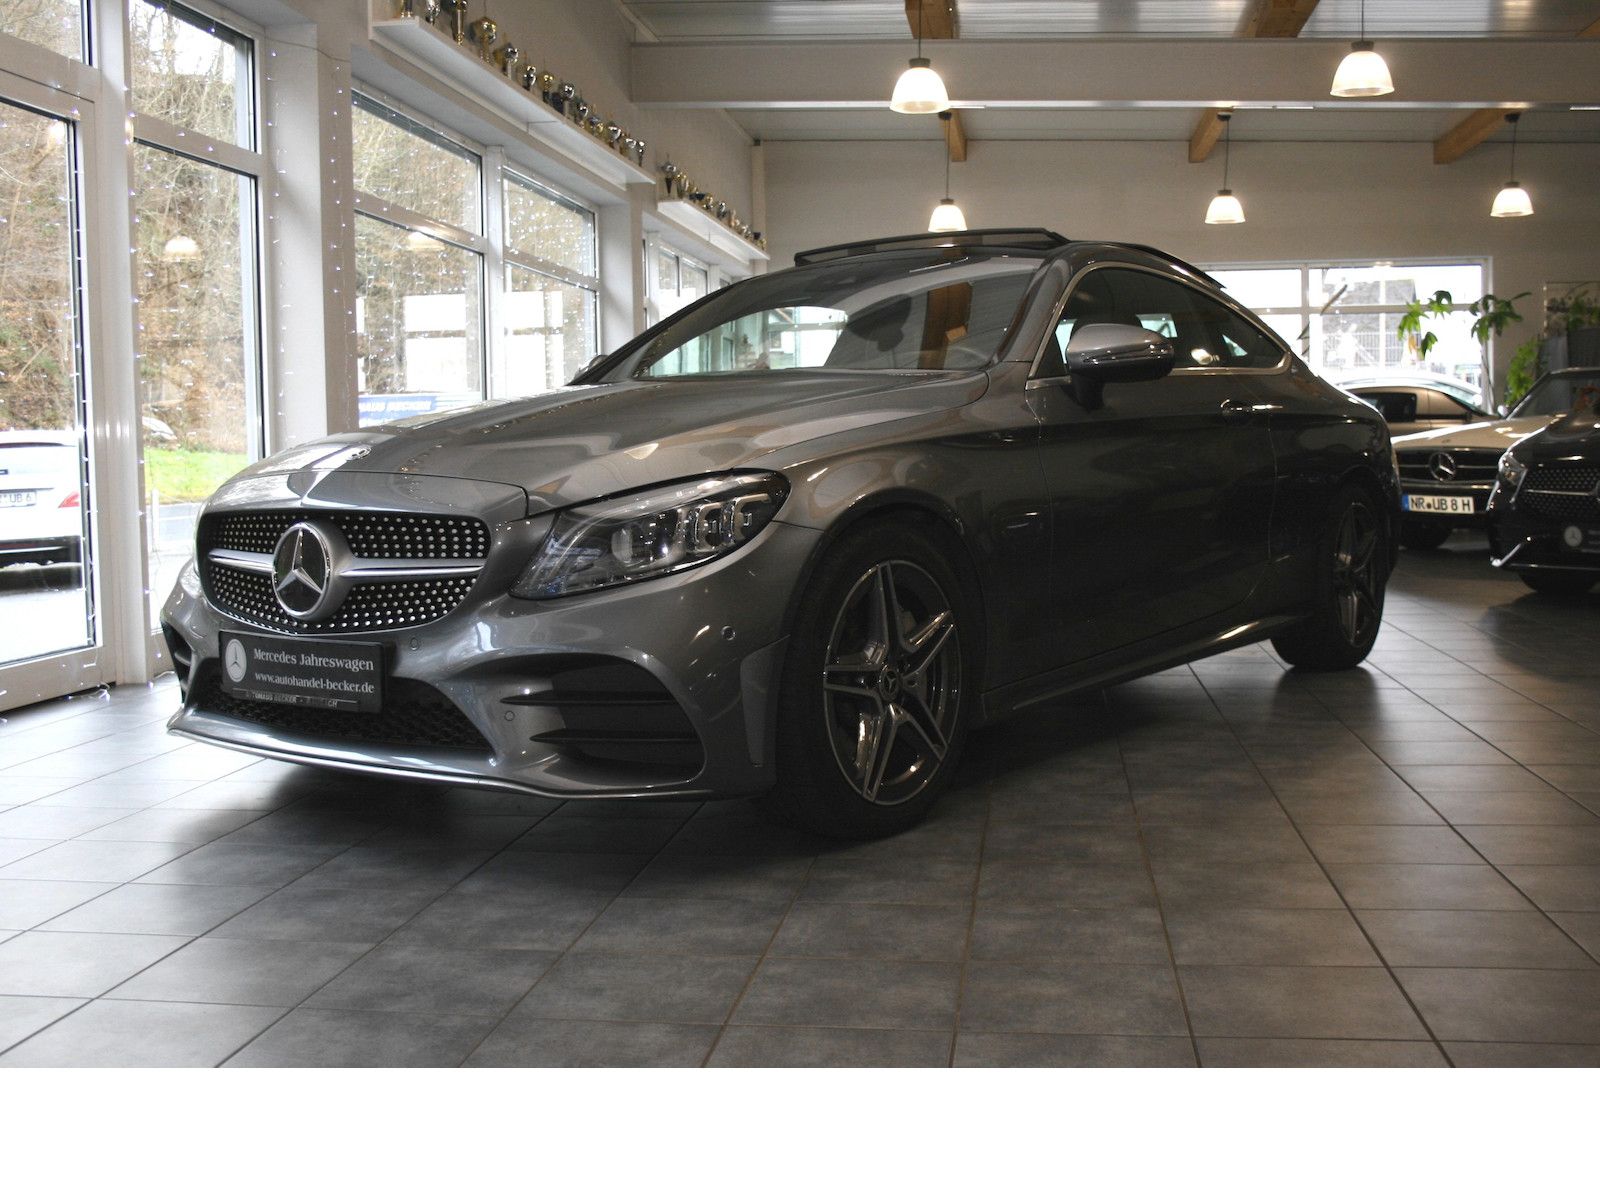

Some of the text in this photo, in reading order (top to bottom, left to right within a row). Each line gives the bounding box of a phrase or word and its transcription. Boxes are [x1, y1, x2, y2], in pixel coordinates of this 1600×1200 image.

[1432, 498, 1448, 511] UB
[1451, 499, 1458, 511] 8
[1462, 499, 1471, 511] H
[253, 648, 374, 673] Mercedes Jahreswagen
[254, 672, 375, 694] www.autohandel-becker.de
